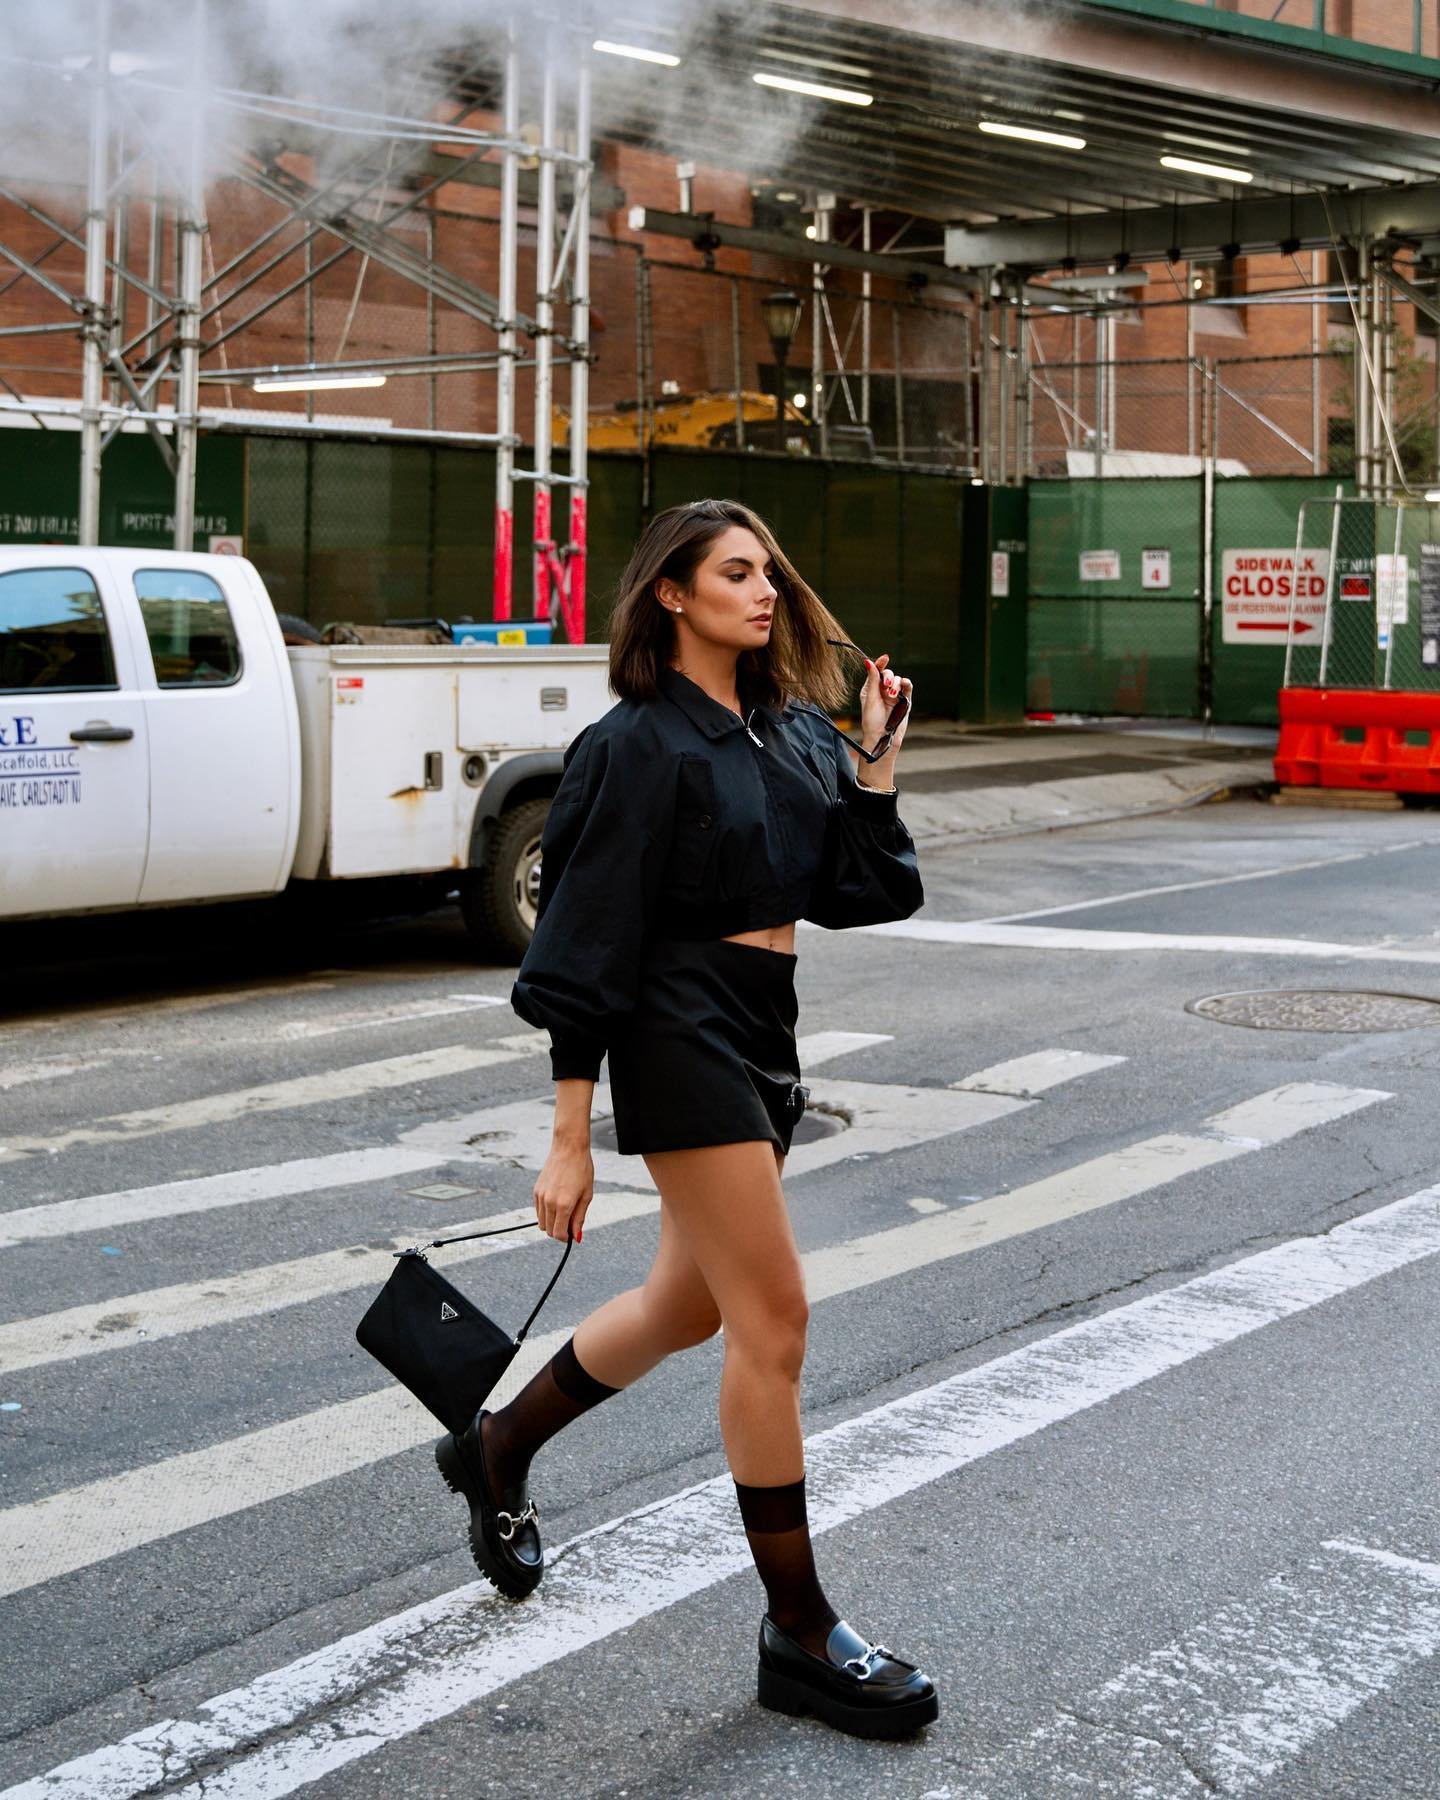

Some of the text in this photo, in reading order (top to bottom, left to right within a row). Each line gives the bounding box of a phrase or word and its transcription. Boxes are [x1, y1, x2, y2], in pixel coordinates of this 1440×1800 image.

[122, 512, 162, 531] POST
[1235, 558, 1315, 572] SIDEWAK
[1151, 568, 1161, 582] 4
[1226, 576, 1326, 597] CLOSED
[1240, 603, 1287, 614] PEDESTRIAN
[1288, 604, 1327, 615] ALKWAY
[53, 751, 80, 768] LLC.
[22, 779, 69, 807] CARLSTADT
[71, 779, 82, 805] NJ
